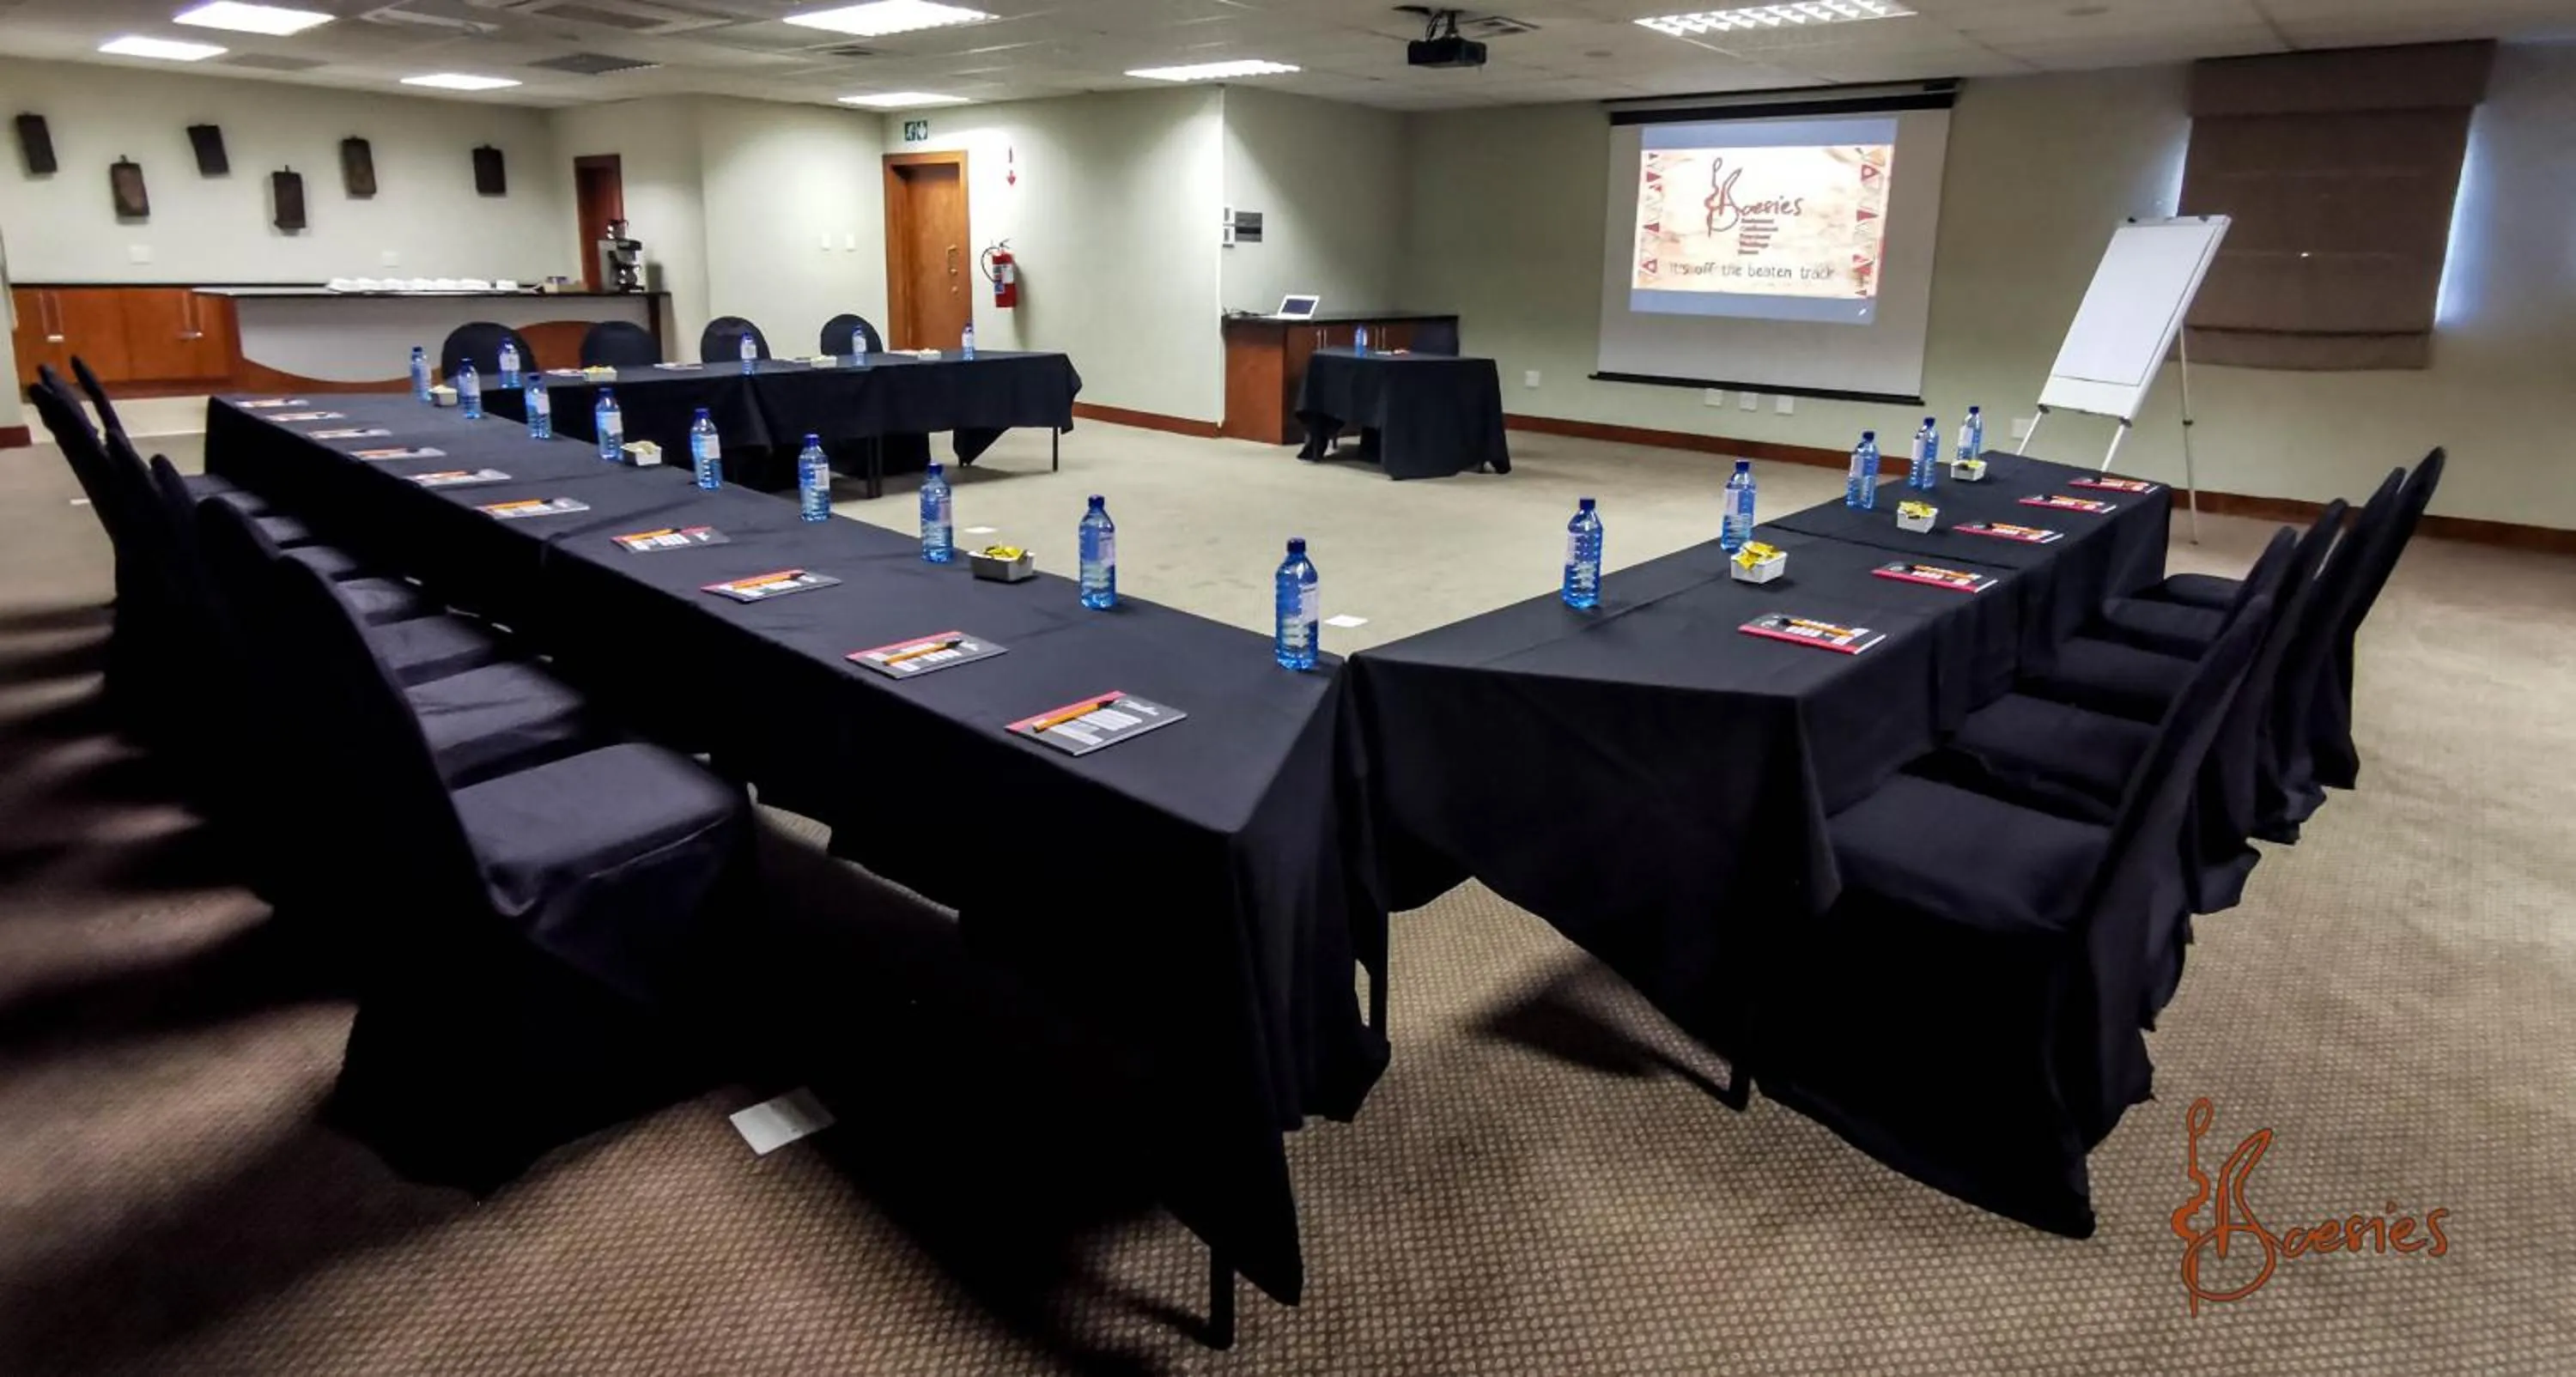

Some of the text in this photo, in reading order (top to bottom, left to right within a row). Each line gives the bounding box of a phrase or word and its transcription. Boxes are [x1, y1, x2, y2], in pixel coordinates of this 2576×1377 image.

[1693, 262, 1716, 276] off
[1722, 264, 1742, 277] the
[1747, 264, 1792, 279] beaten
[1800, 265, 1835, 280] track
